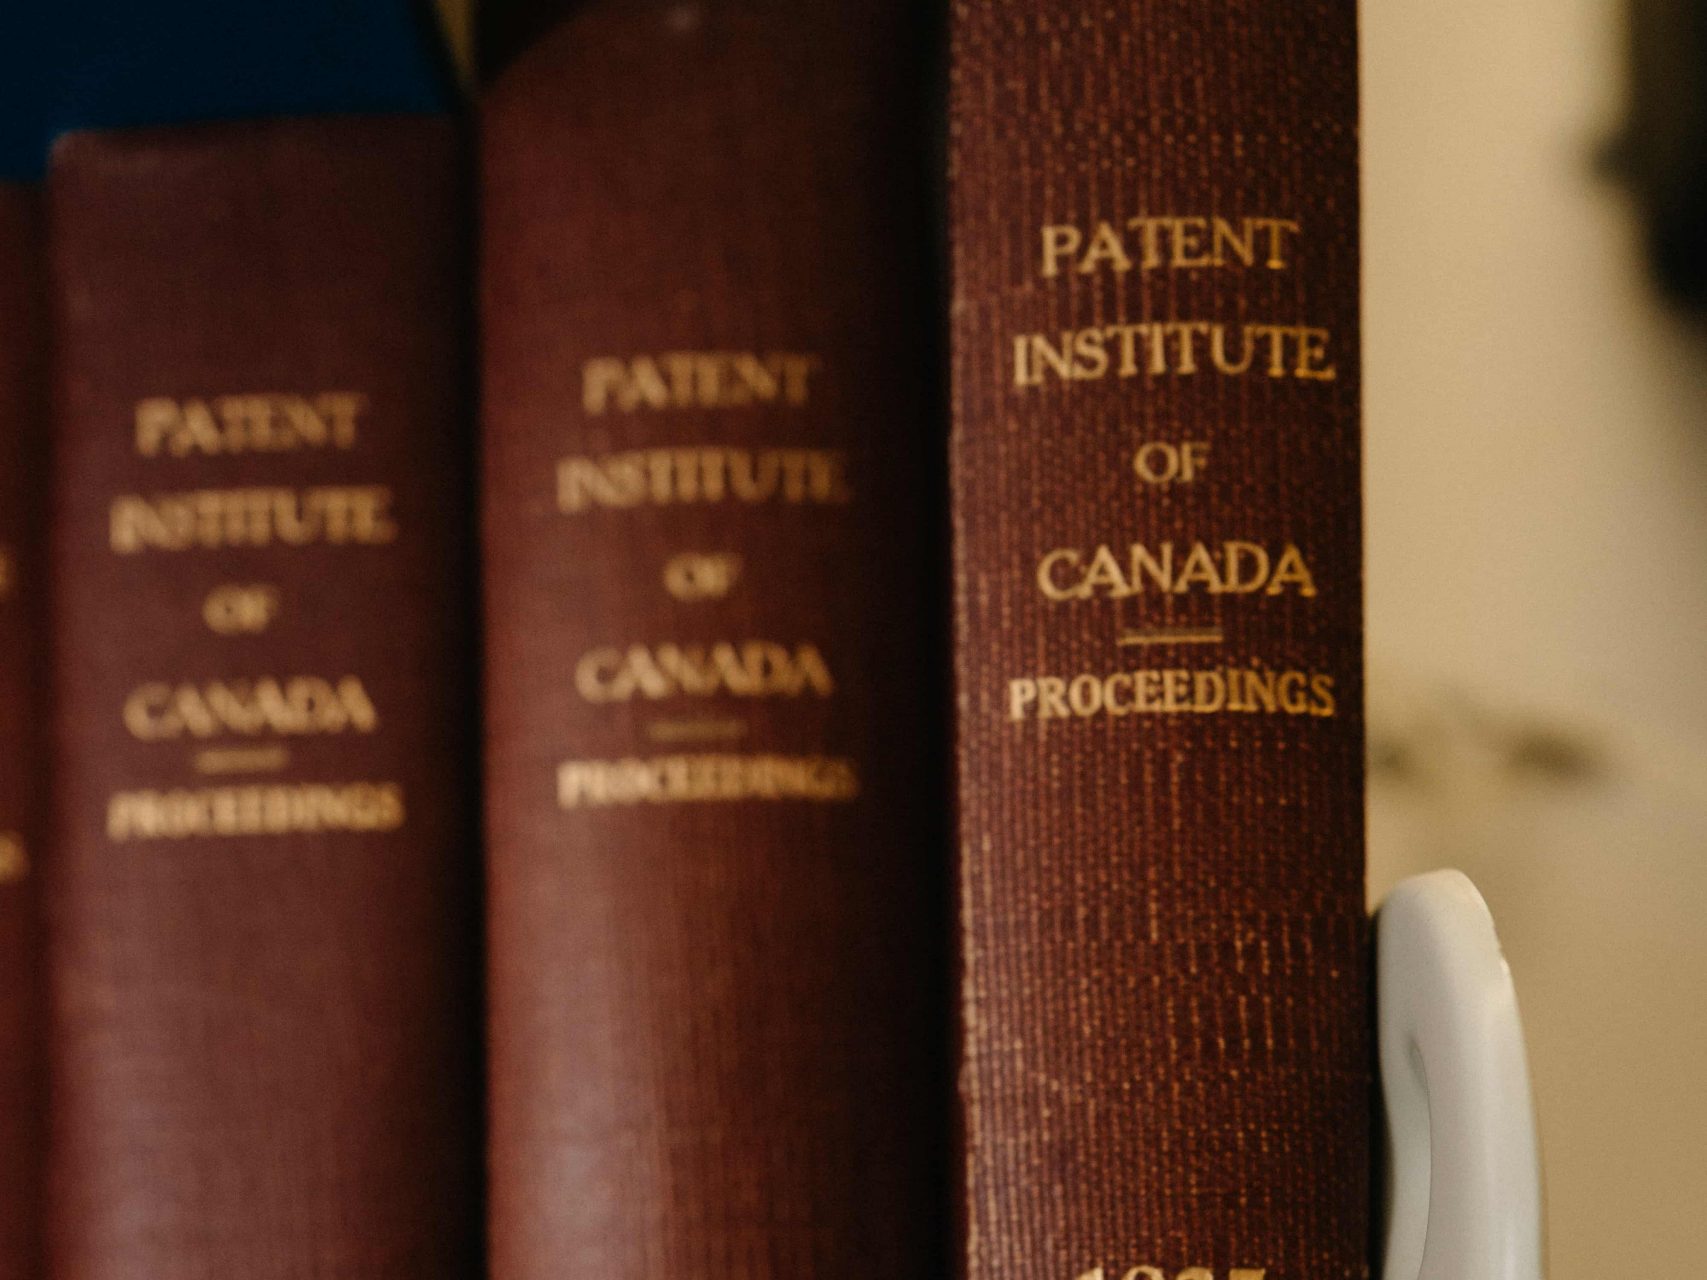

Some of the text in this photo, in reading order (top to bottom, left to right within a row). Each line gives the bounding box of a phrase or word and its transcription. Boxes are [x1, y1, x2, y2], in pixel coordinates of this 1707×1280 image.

[1041, 216, 1300, 277] PATENT
[1012, 322, 1337, 386] INSTITUTE
[1133, 441, 1211, 484] OF
[1036, 541, 1318, 600] CANADA
[1008, 668, 1336, 722] PROCEEDINGS
